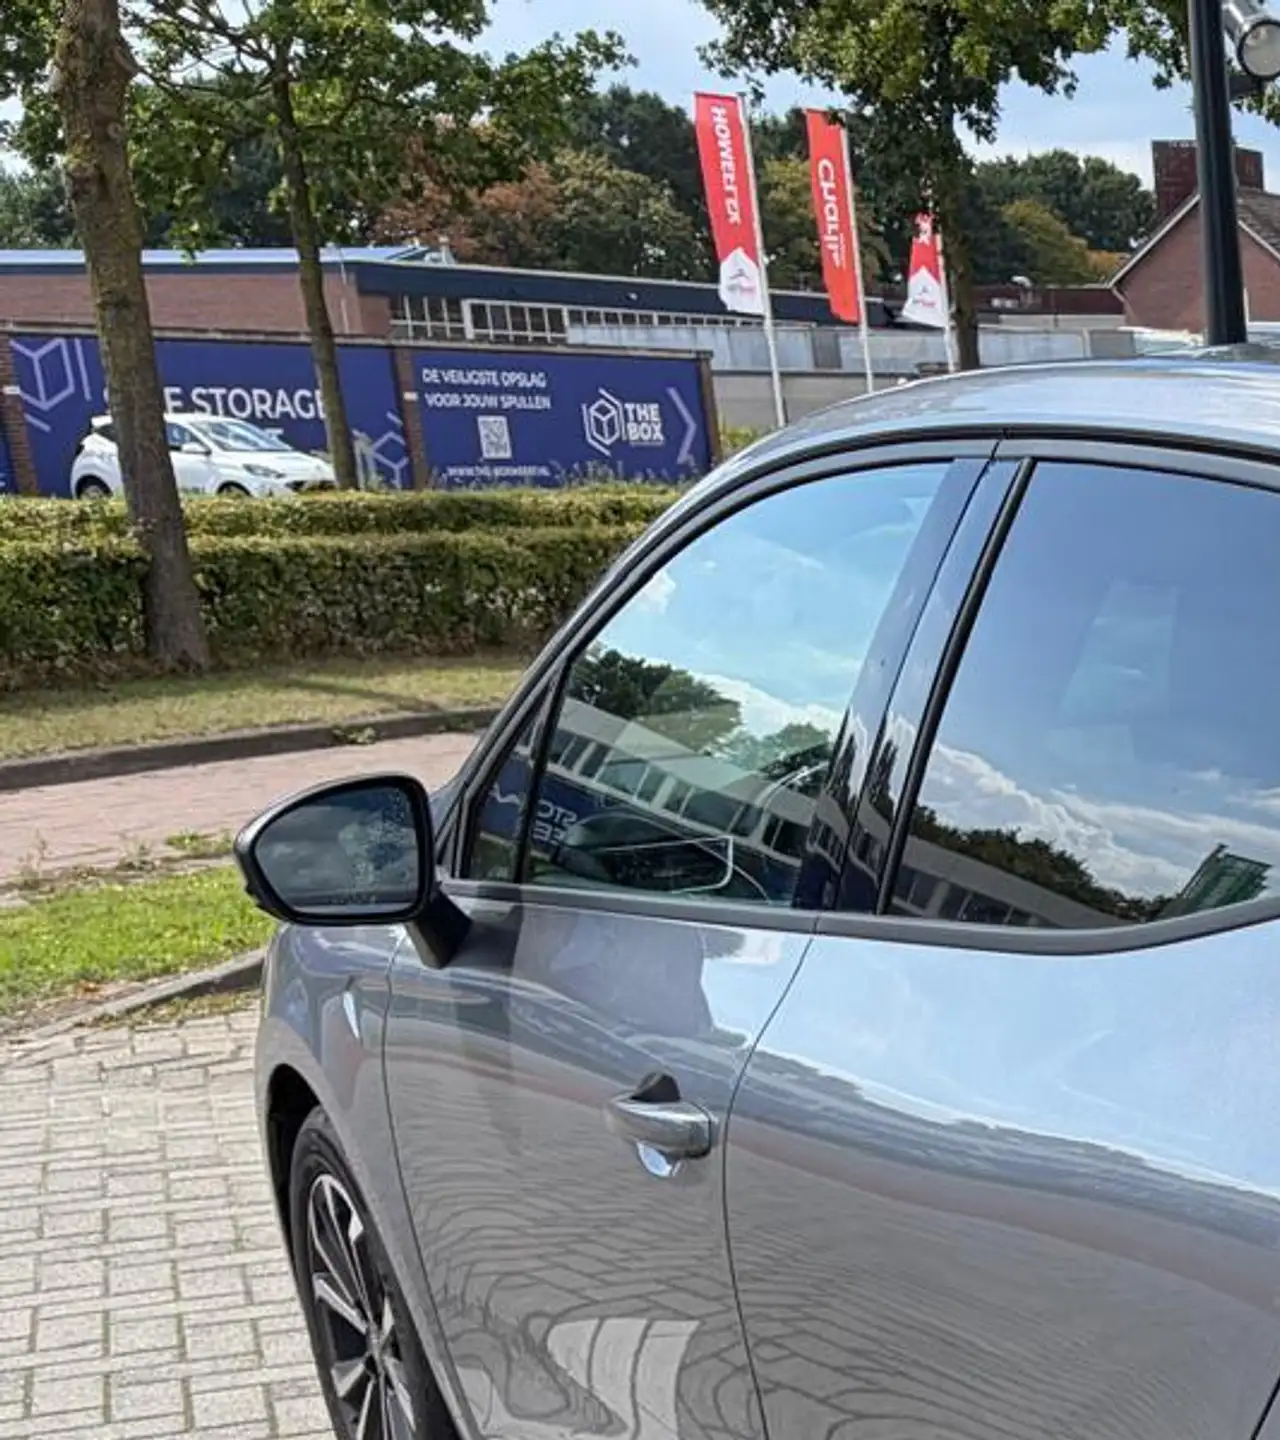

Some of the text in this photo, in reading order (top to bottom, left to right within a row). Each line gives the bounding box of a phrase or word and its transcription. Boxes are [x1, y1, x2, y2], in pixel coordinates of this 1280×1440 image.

[421, 367, 440, 384] DE
[624, 403, 661, 421] THE
[627, 422, 664, 441] BOX
